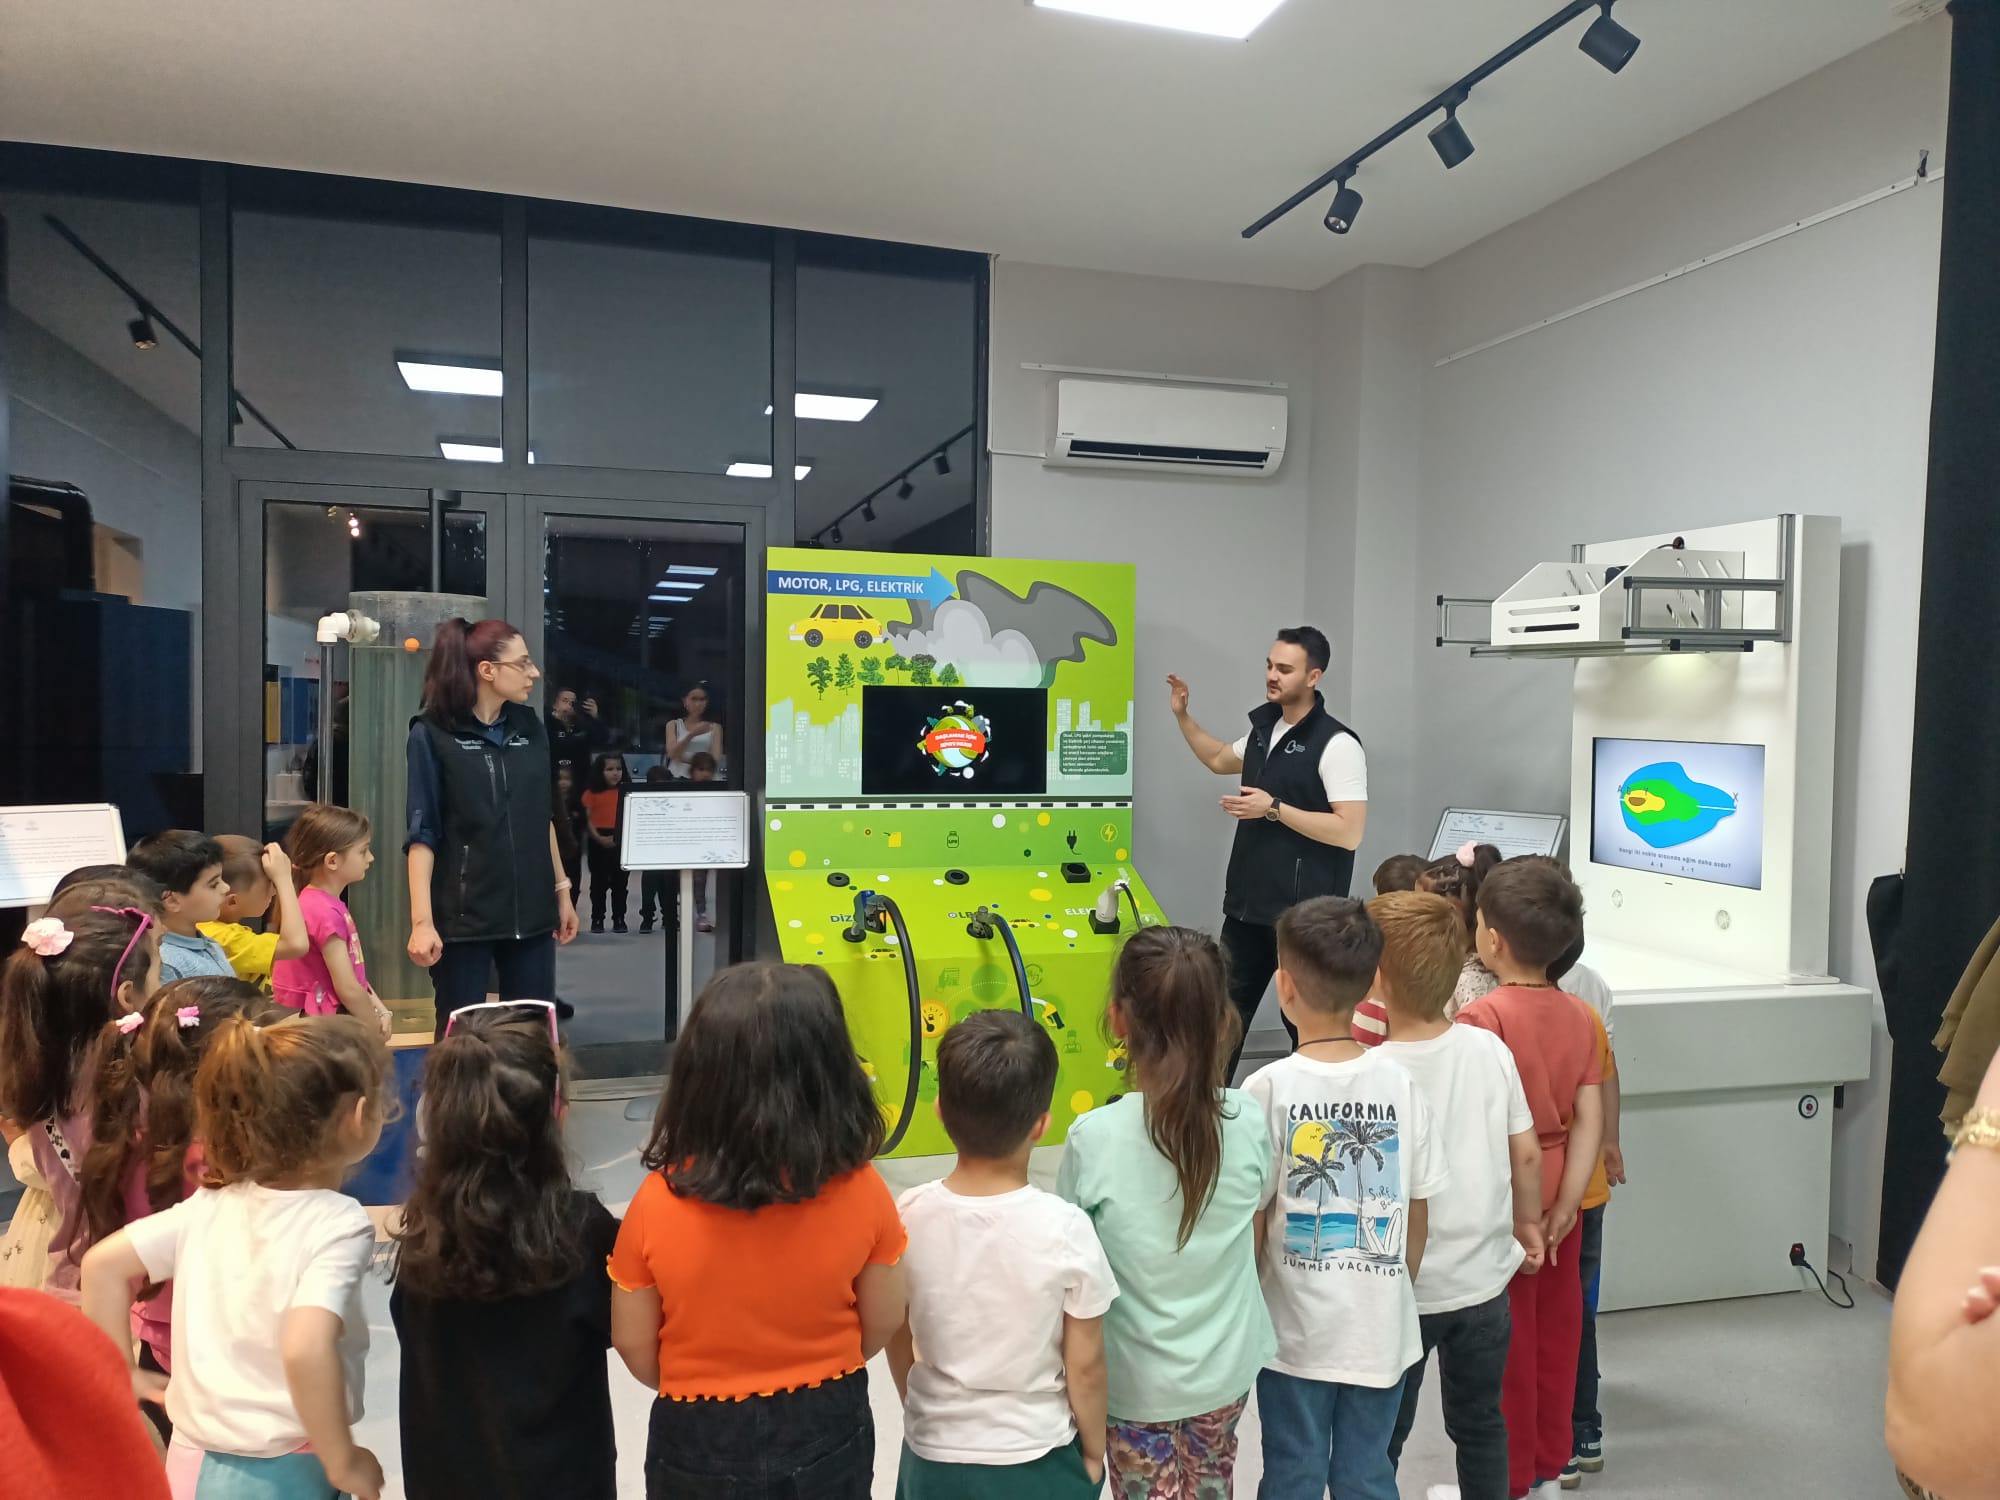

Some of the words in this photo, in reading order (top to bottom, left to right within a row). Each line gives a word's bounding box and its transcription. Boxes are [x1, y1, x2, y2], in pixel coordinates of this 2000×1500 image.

[778, 576, 832, 592] MOTOR,
[835, 579, 864, 594] LPG,
[867, 580, 925, 594] ELEKTRİK
[1732, 792, 1738, 802] X
[1289, 1101, 1397, 1122] CALIFORNIA
[1283, 1255, 1331, 1272] SUMMER
[1337, 1261, 1403, 1277] VACATION
